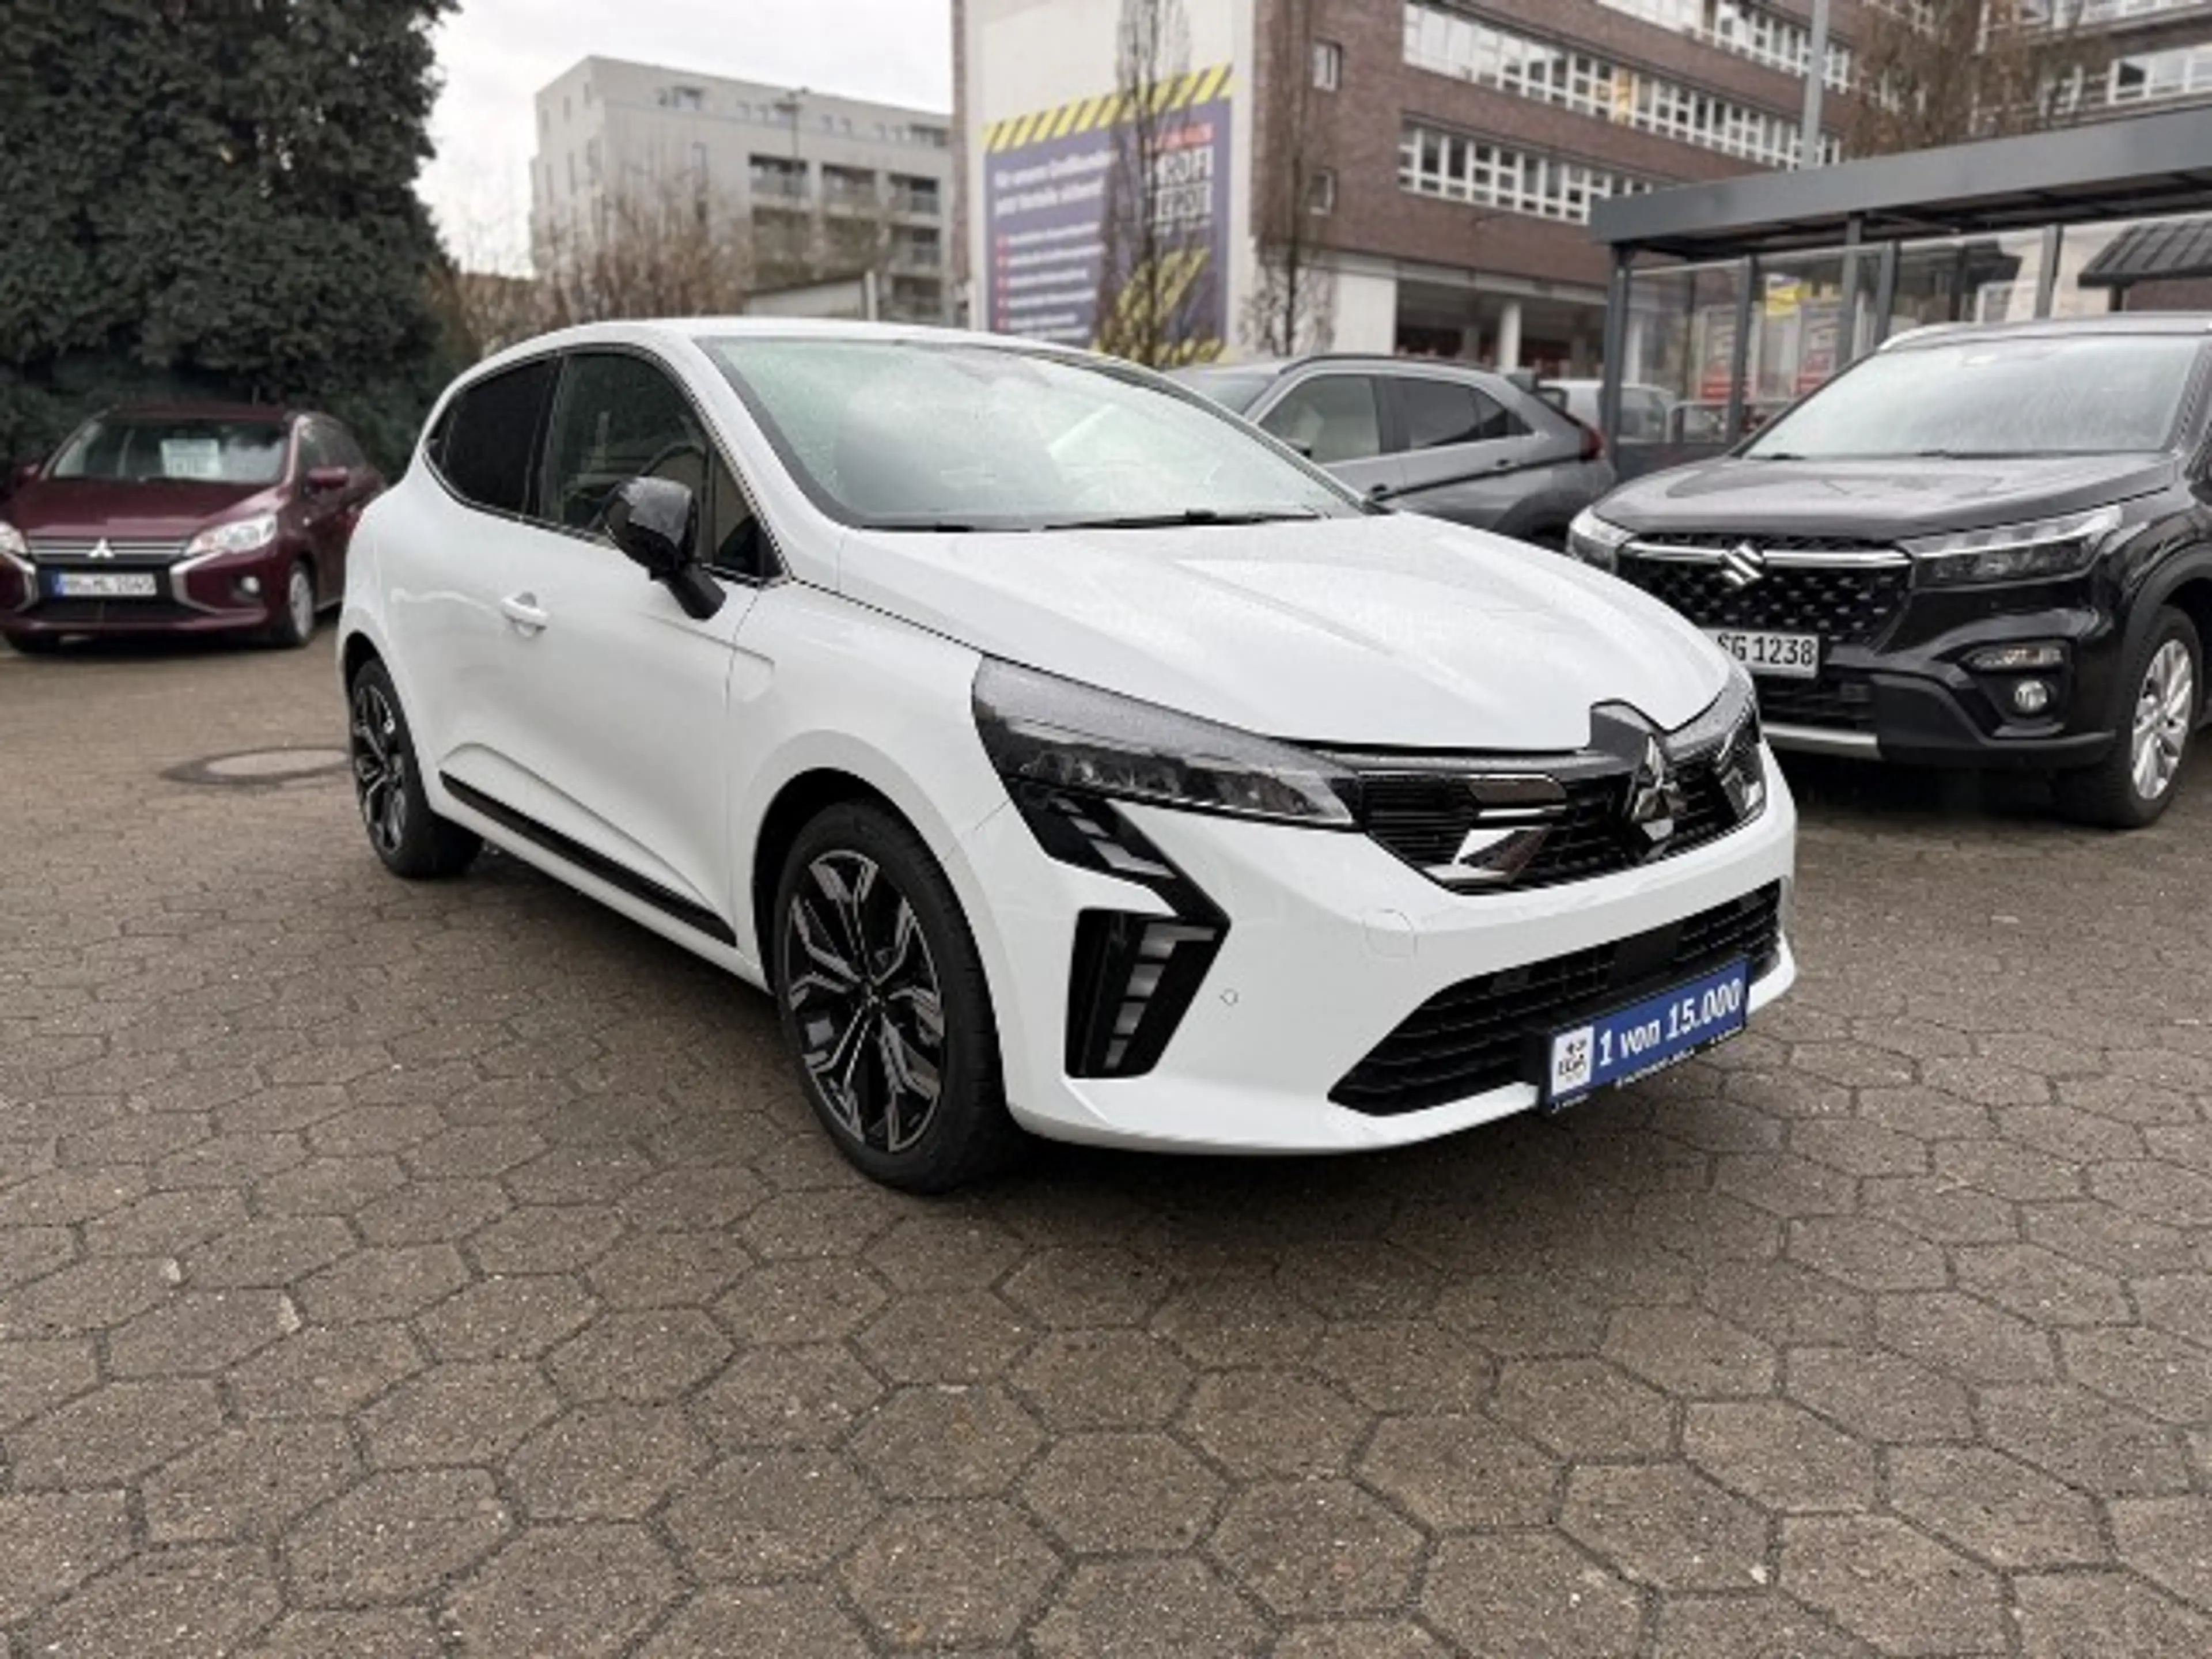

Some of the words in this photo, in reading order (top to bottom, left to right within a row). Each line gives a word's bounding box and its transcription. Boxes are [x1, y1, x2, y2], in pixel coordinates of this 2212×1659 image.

[1753, 636, 1814, 666] 1238
[1599, 1029, 1613, 1067] 1
[1620, 1019, 1661, 1059] von
[1665, 978, 1743, 1041] 15.000
